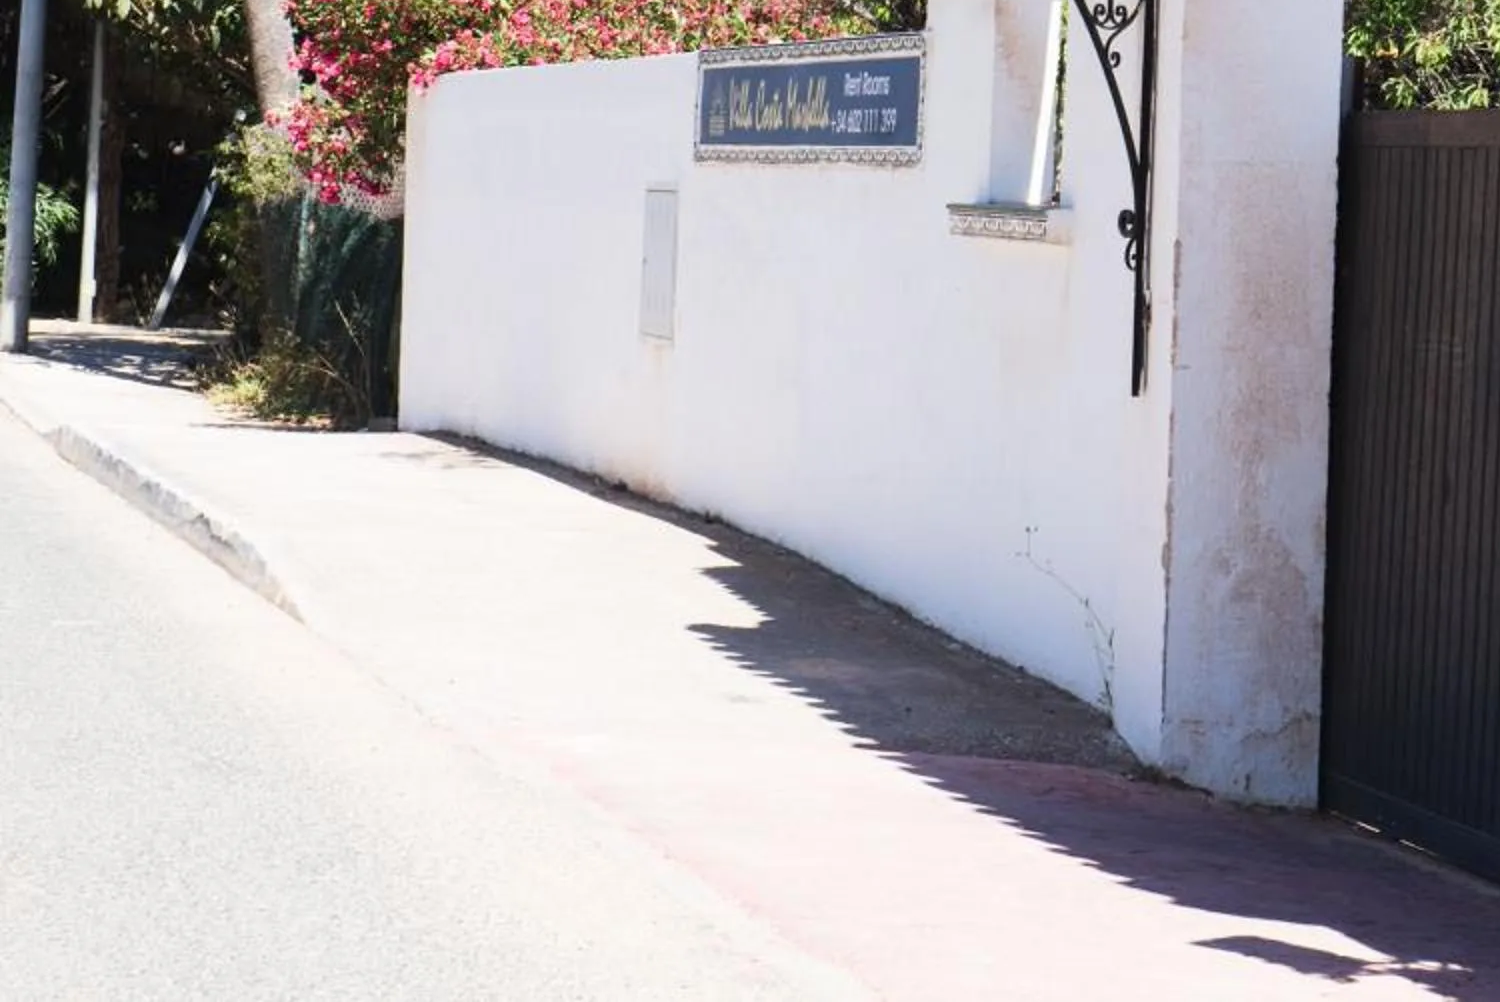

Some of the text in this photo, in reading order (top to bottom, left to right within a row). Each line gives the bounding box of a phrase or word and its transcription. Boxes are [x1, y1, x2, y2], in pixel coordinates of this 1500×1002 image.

[843, 71, 890, 97] Rent Rooms
[831, 109, 846, 134] +34
